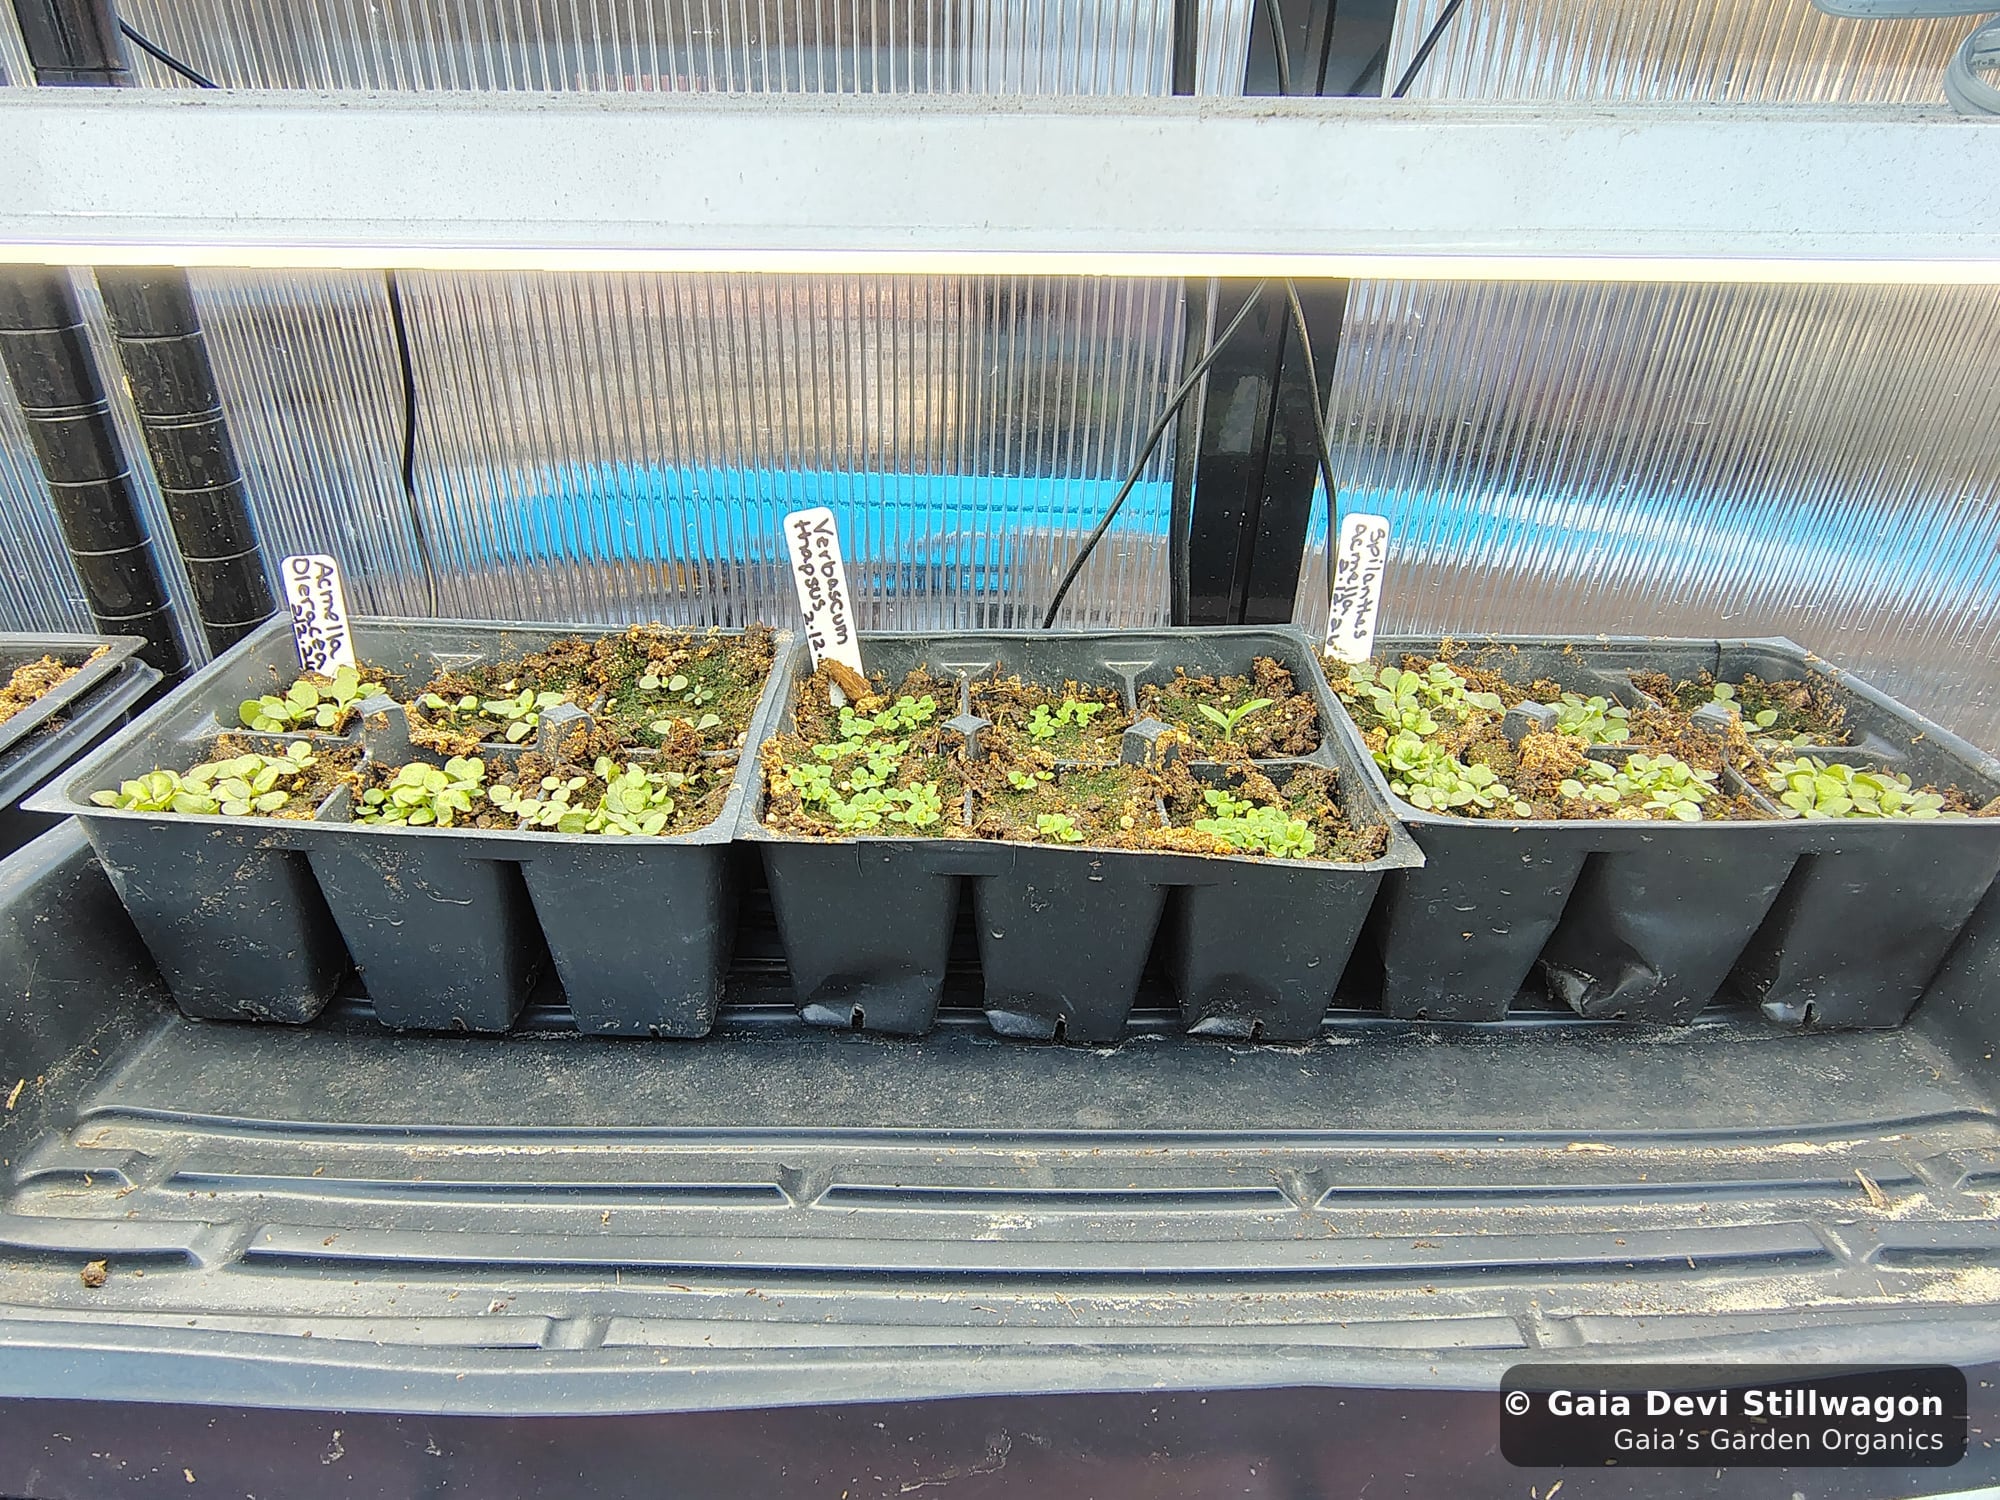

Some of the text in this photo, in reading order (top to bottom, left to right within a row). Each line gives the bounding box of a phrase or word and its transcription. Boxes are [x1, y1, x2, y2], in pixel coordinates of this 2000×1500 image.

[314, 561, 344, 660] Acmella
[794, 519, 826, 612] thapsus
[813, 517, 849, 645] Verbascum
[1353, 528, 1386, 640] Spilanthes
